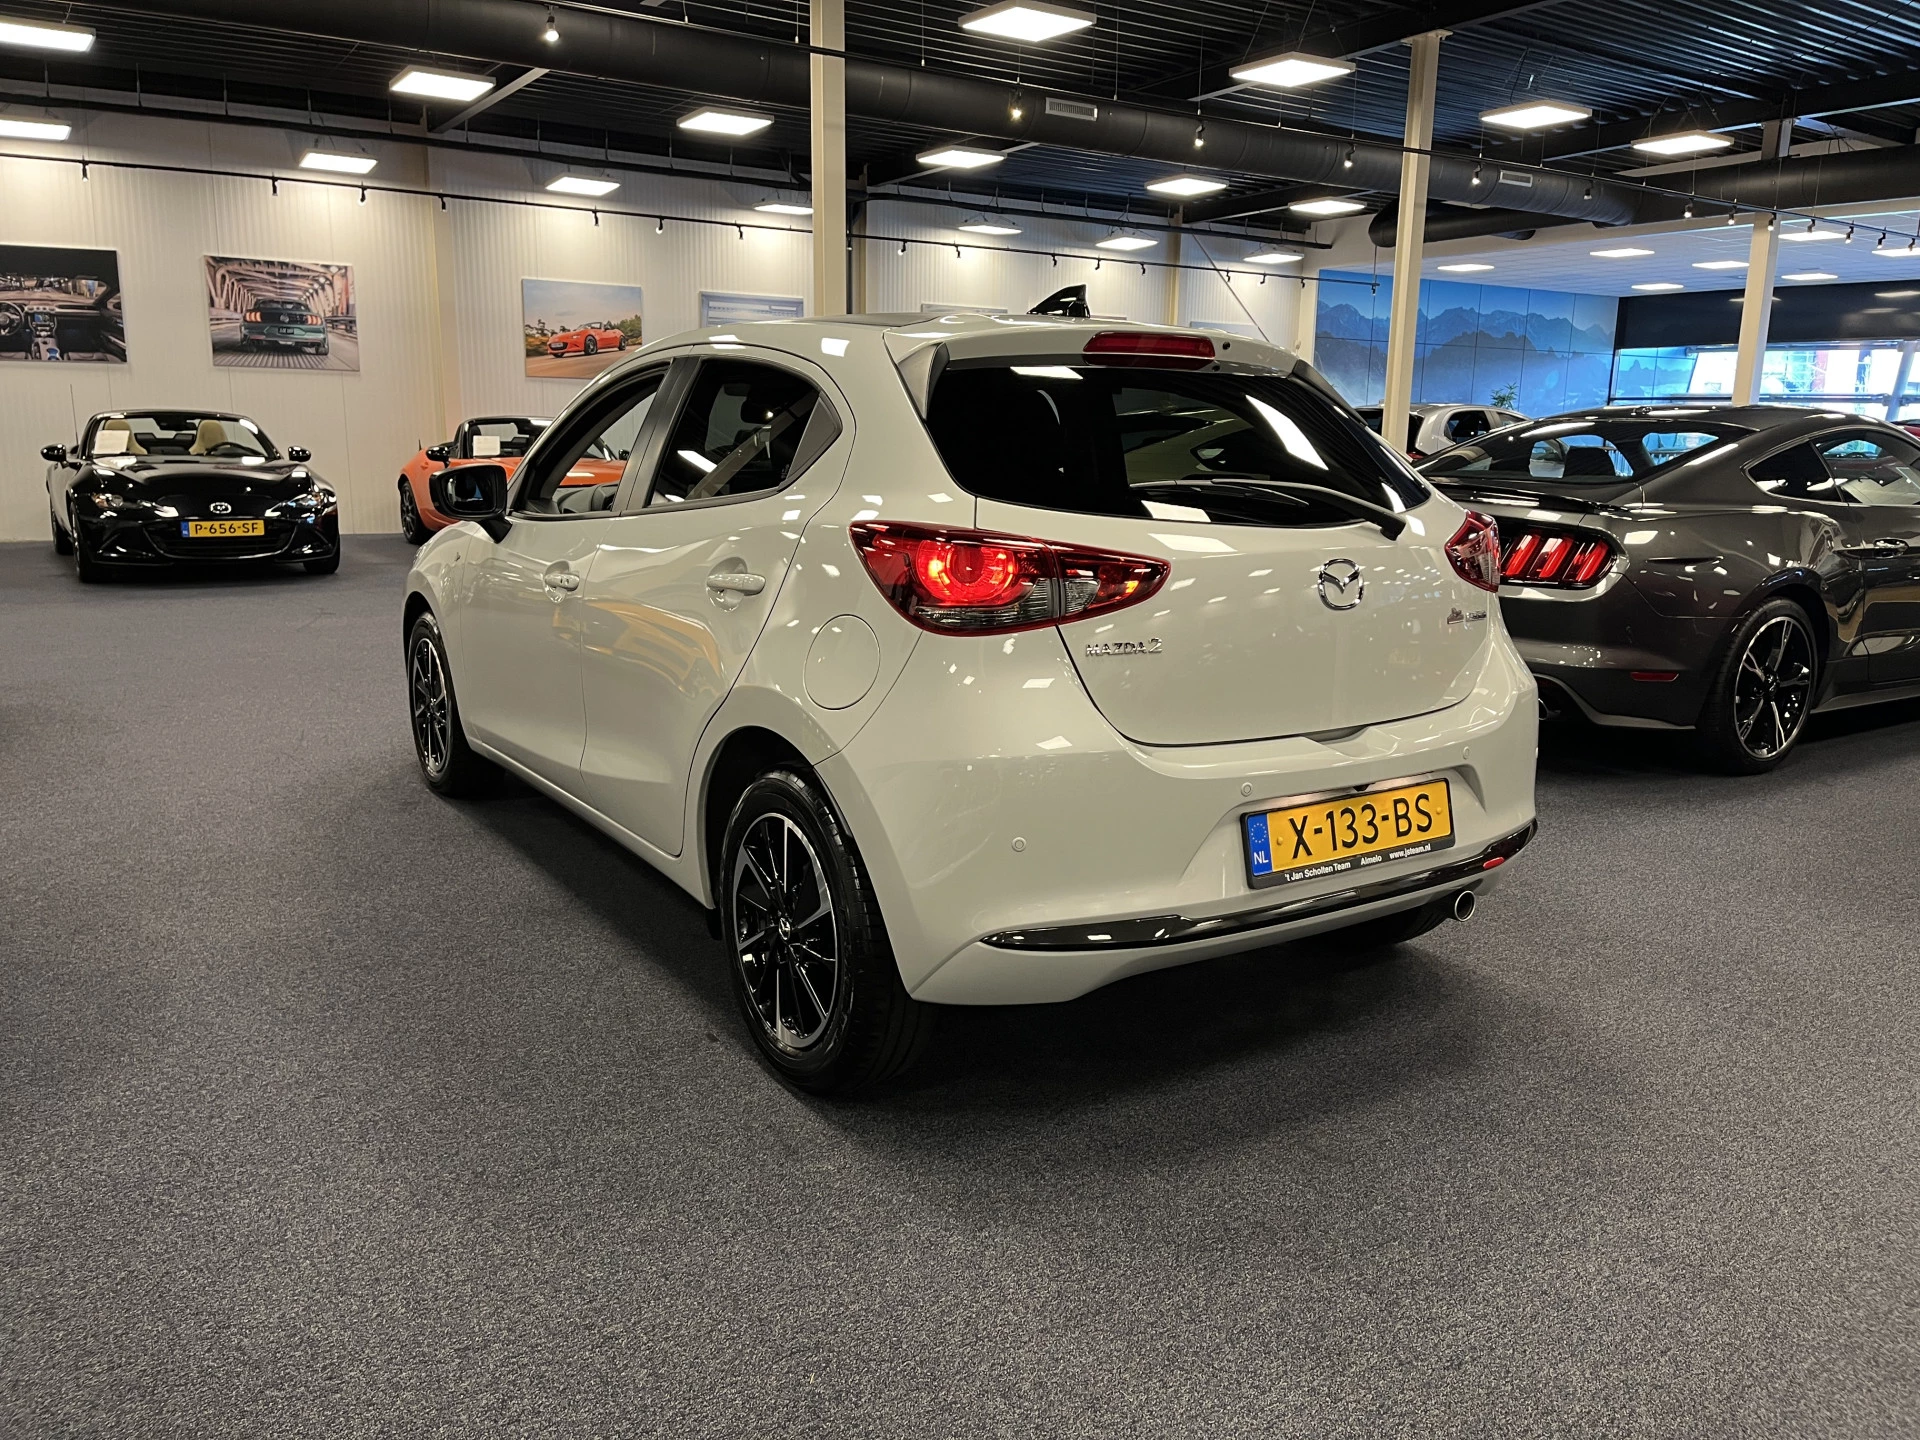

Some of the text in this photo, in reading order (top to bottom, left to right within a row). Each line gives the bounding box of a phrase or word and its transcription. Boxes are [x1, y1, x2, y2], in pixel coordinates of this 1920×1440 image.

[194, 522, 258, 535] P-656-SF
[1288, 793, 1433, 860] X-133-BS
[1253, 850, 1270, 866] NL
[1388, 843, 1432, 860] www.jsteam.nl
[1360, 855, 1382, 866] Almelo
[1290, 871, 1304, 881] Jan
[1304, 865, 1334, 878] Scholten
[1333, 861, 1351, 872] Team
